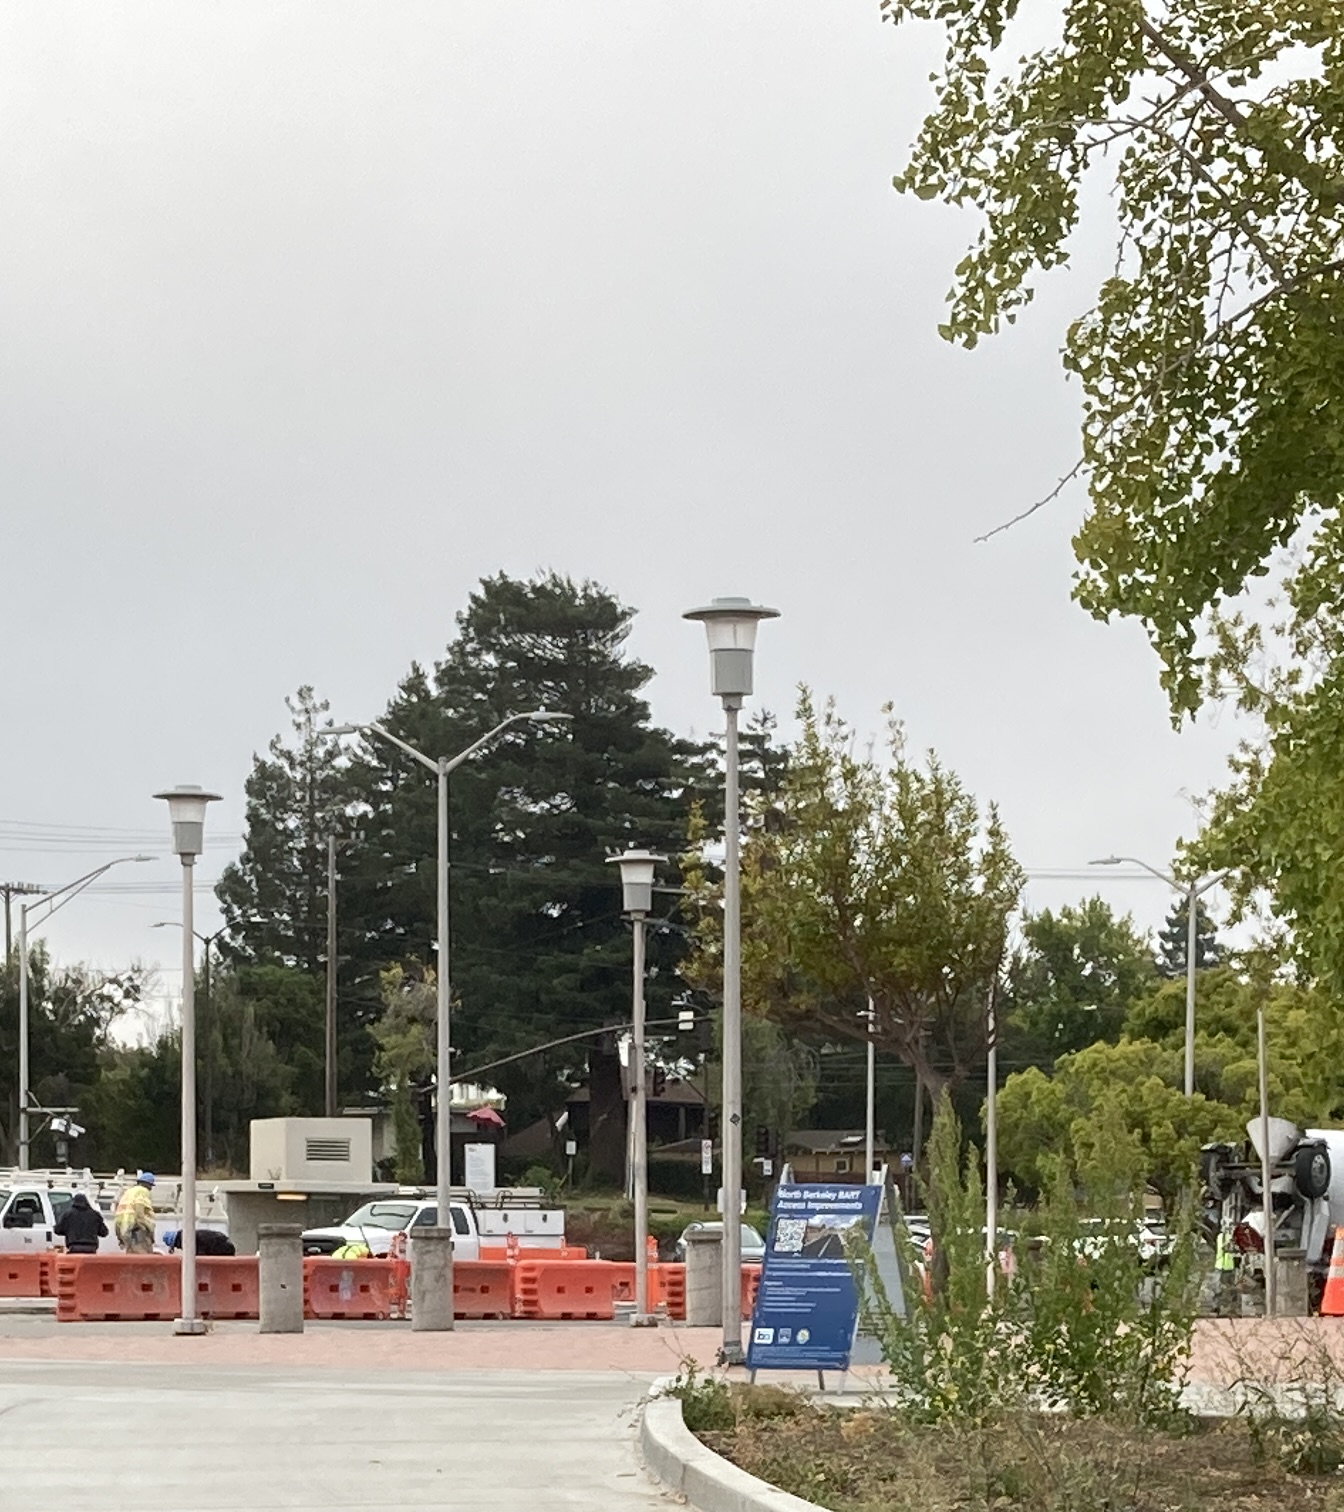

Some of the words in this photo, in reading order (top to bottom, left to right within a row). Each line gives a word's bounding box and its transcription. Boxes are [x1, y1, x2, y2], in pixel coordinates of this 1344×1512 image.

[777, 1188, 802, 1199] North
[803, 1190, 837, 1200] Berkeley
[838, 1191, 861, 1200] BART
[807, 1201, 863, 1211] Improvements
